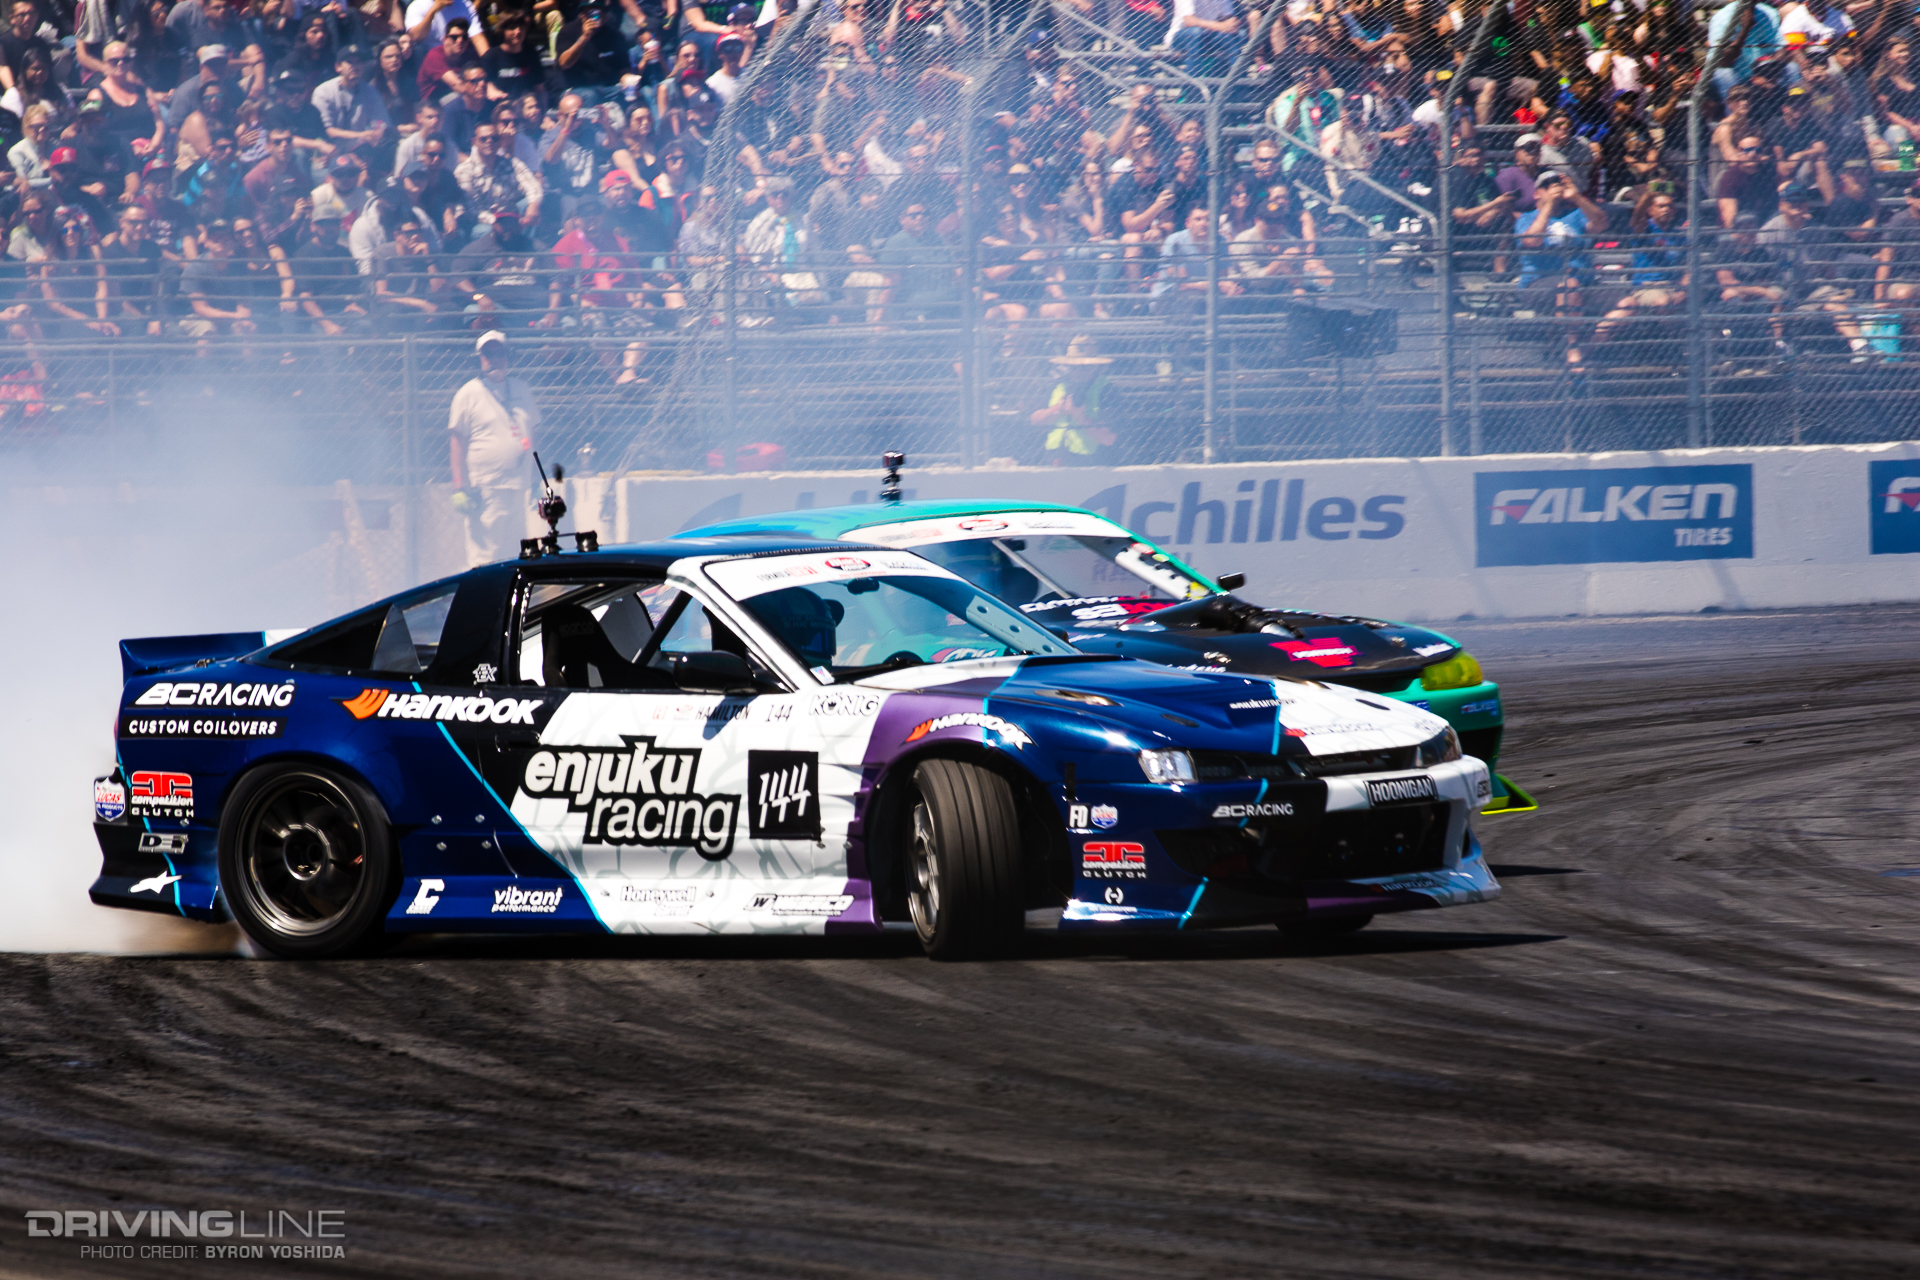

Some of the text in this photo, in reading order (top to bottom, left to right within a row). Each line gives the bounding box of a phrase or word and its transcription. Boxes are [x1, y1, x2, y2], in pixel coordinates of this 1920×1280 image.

[1078, 478, 1407, 545] Achilles
[1487, 483, 1738, 526] FALKEN
[1674, 527, 1733, 547] TIRES
[694, 702, 752, 722] HAMILTON
[764, 703, 794, 722] 144
[128, 719, 278, 736] CUSTOM COILOVERS
[524, 742, 694, 806] enjuku
[97, 791, 122, 804] LUCAS
[759, 762, 812, 829] 144
[1371, 778, 1433, 802] HOONIGAN
[131, 794, 194, 808] competition
[131, 807, 195, 818] CLUTCH
[589, 797, 735, 854] racing
[494, 885, 564, 906] vibrant
[620, 886, 697, 905] Honeywell
[491, 903, 557, 913] performance
